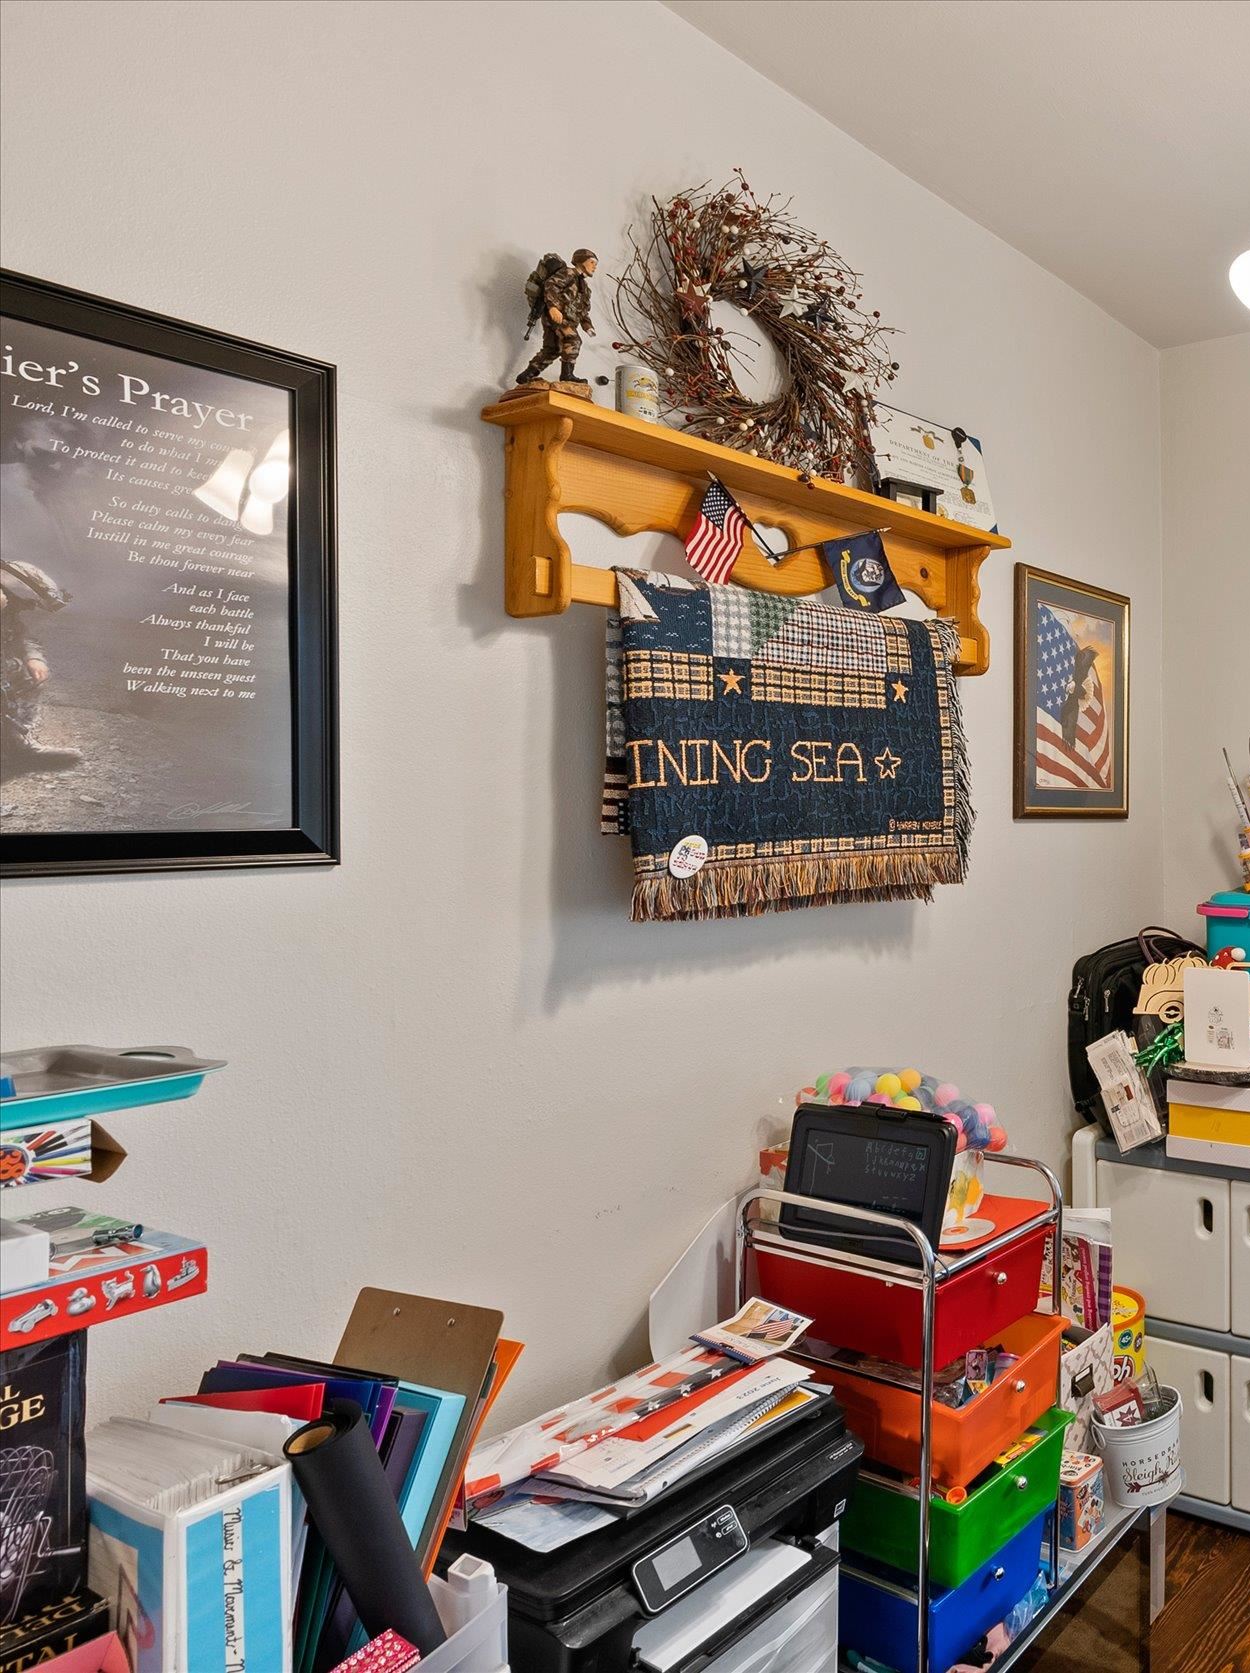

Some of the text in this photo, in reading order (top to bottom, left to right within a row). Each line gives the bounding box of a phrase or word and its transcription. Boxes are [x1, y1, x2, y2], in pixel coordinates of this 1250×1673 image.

[1, 344, 254, 432] ier's Prayer
[11, 395, 55, 416] Lord,
[63, 405, 87, 422] I'm
[92, 411, 132, 430] called
[136, 421, 149, 434] to
[152, 427, 184, 442] serve
[188, 435, 207, 450] my
[49, 438, 70, 453] To
[73, 442, 121, 465] protect
[126, 454, 137, 467] it
[141, 458, 166, 473] and
[171, 464, 183, 477] to
[120, 438, 134, 449] to
[139, 440, 154, 452] do
[158, 445, 192, 461] what
[105, 468, 124, 481] Its
[128, 474, 169, 491] causes
[108, 495, 127, 509] So
[131, 499, 161, 517] duty
[164, 505, 193, 522] calls
[197, 512, 209, 525] to
[90, 509, 255, 550] Please calm my every fear
[86, 526, 253, 564] Instill in me great courage
[127, 550, 255, 579] Be thou forever near
[161, 582, 250, 604] And as I face
[189, 601, 254, 619] each battle
[140, 613, 251, 636] Always thankful
[204, 635, 255, 652] I will be
[160, 648, 251, 667] That you have
[123, 661, 256, 684] been the unseen guest
[126, 679, 256, 699] Walking next to me
[790, 740, 867, 783] SEA
[1123, 1462, 1161, 1484] Sleigh
[223, 1559, 243, 1576] &
